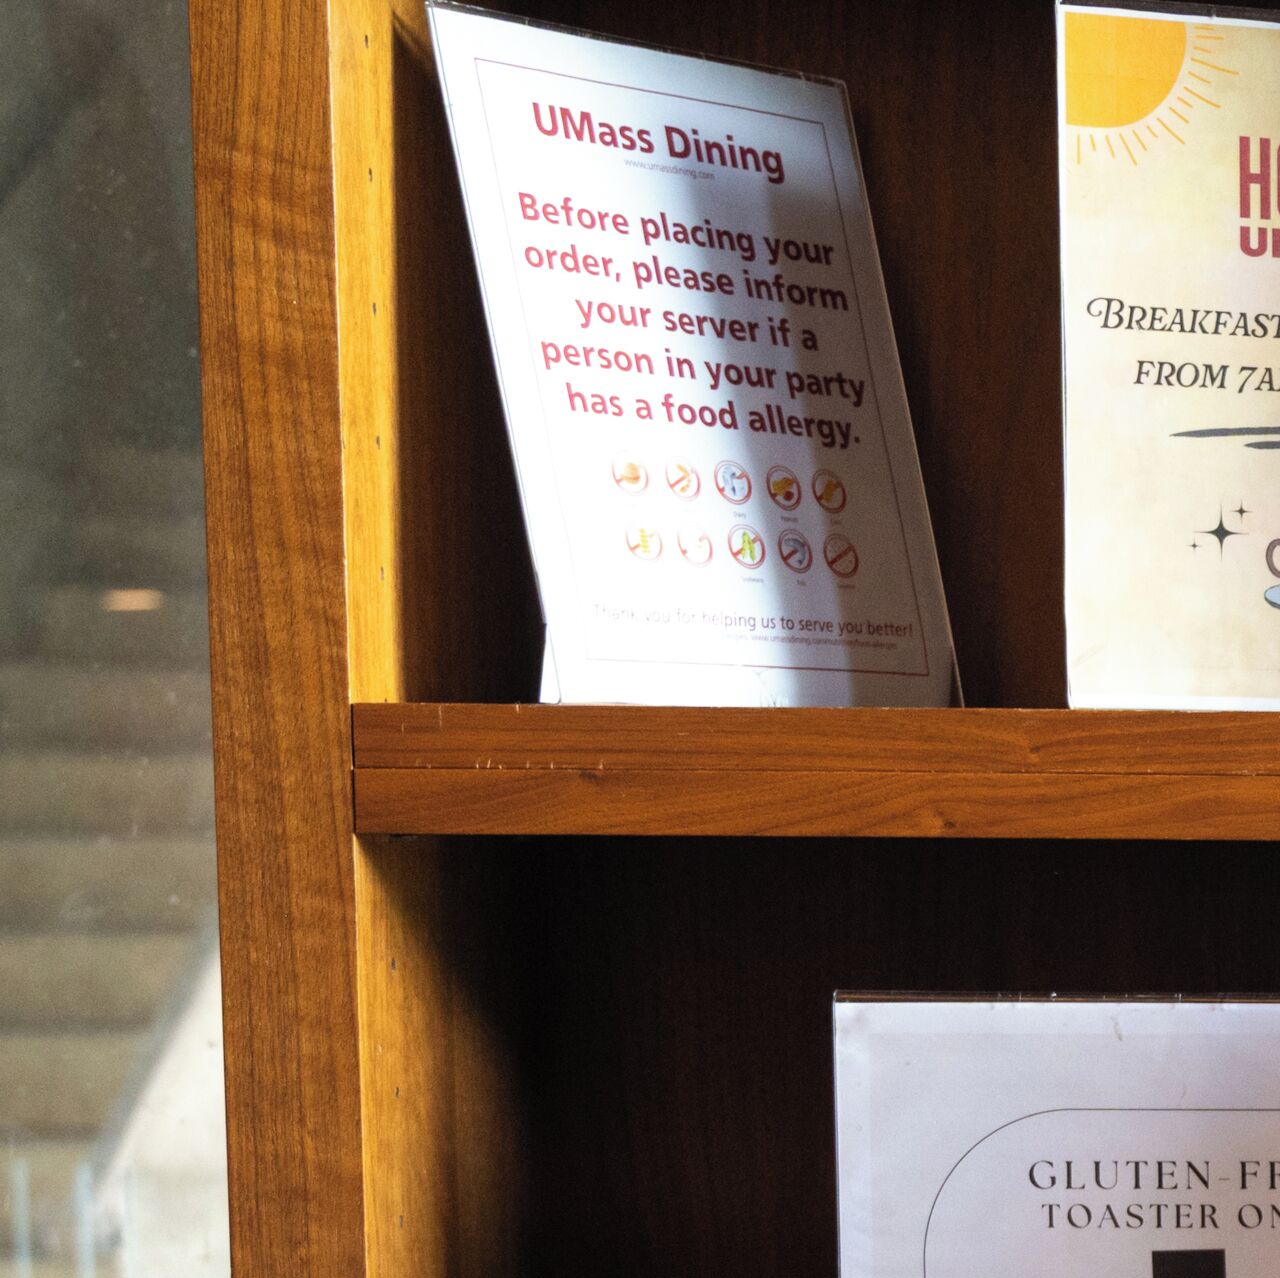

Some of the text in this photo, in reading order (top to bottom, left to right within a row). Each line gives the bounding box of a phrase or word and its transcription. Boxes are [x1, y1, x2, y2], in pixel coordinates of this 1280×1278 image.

[532, 102, 785, 183] UMass Dining
[518, 192, 834, 265] Before placing your
[524, 244, 848, 311] order, please inform
[575, 299, 818, 350] your server if a
[541, 340, 865, 408] person in your party
[1134, 360, 1229, 389] FROM
[566, 382, 861, 449] has a food allergy.
[702, 611, 756, 631] helping
[761, 617, 776, 629] us
[780, 616, 795, 630] to
[798, 620, 834, 633] serve
[838, 622, 863, 638] you
[867, 621, 914, 637] better!
[1042, 1203, 1221, 1230] TOASTER
